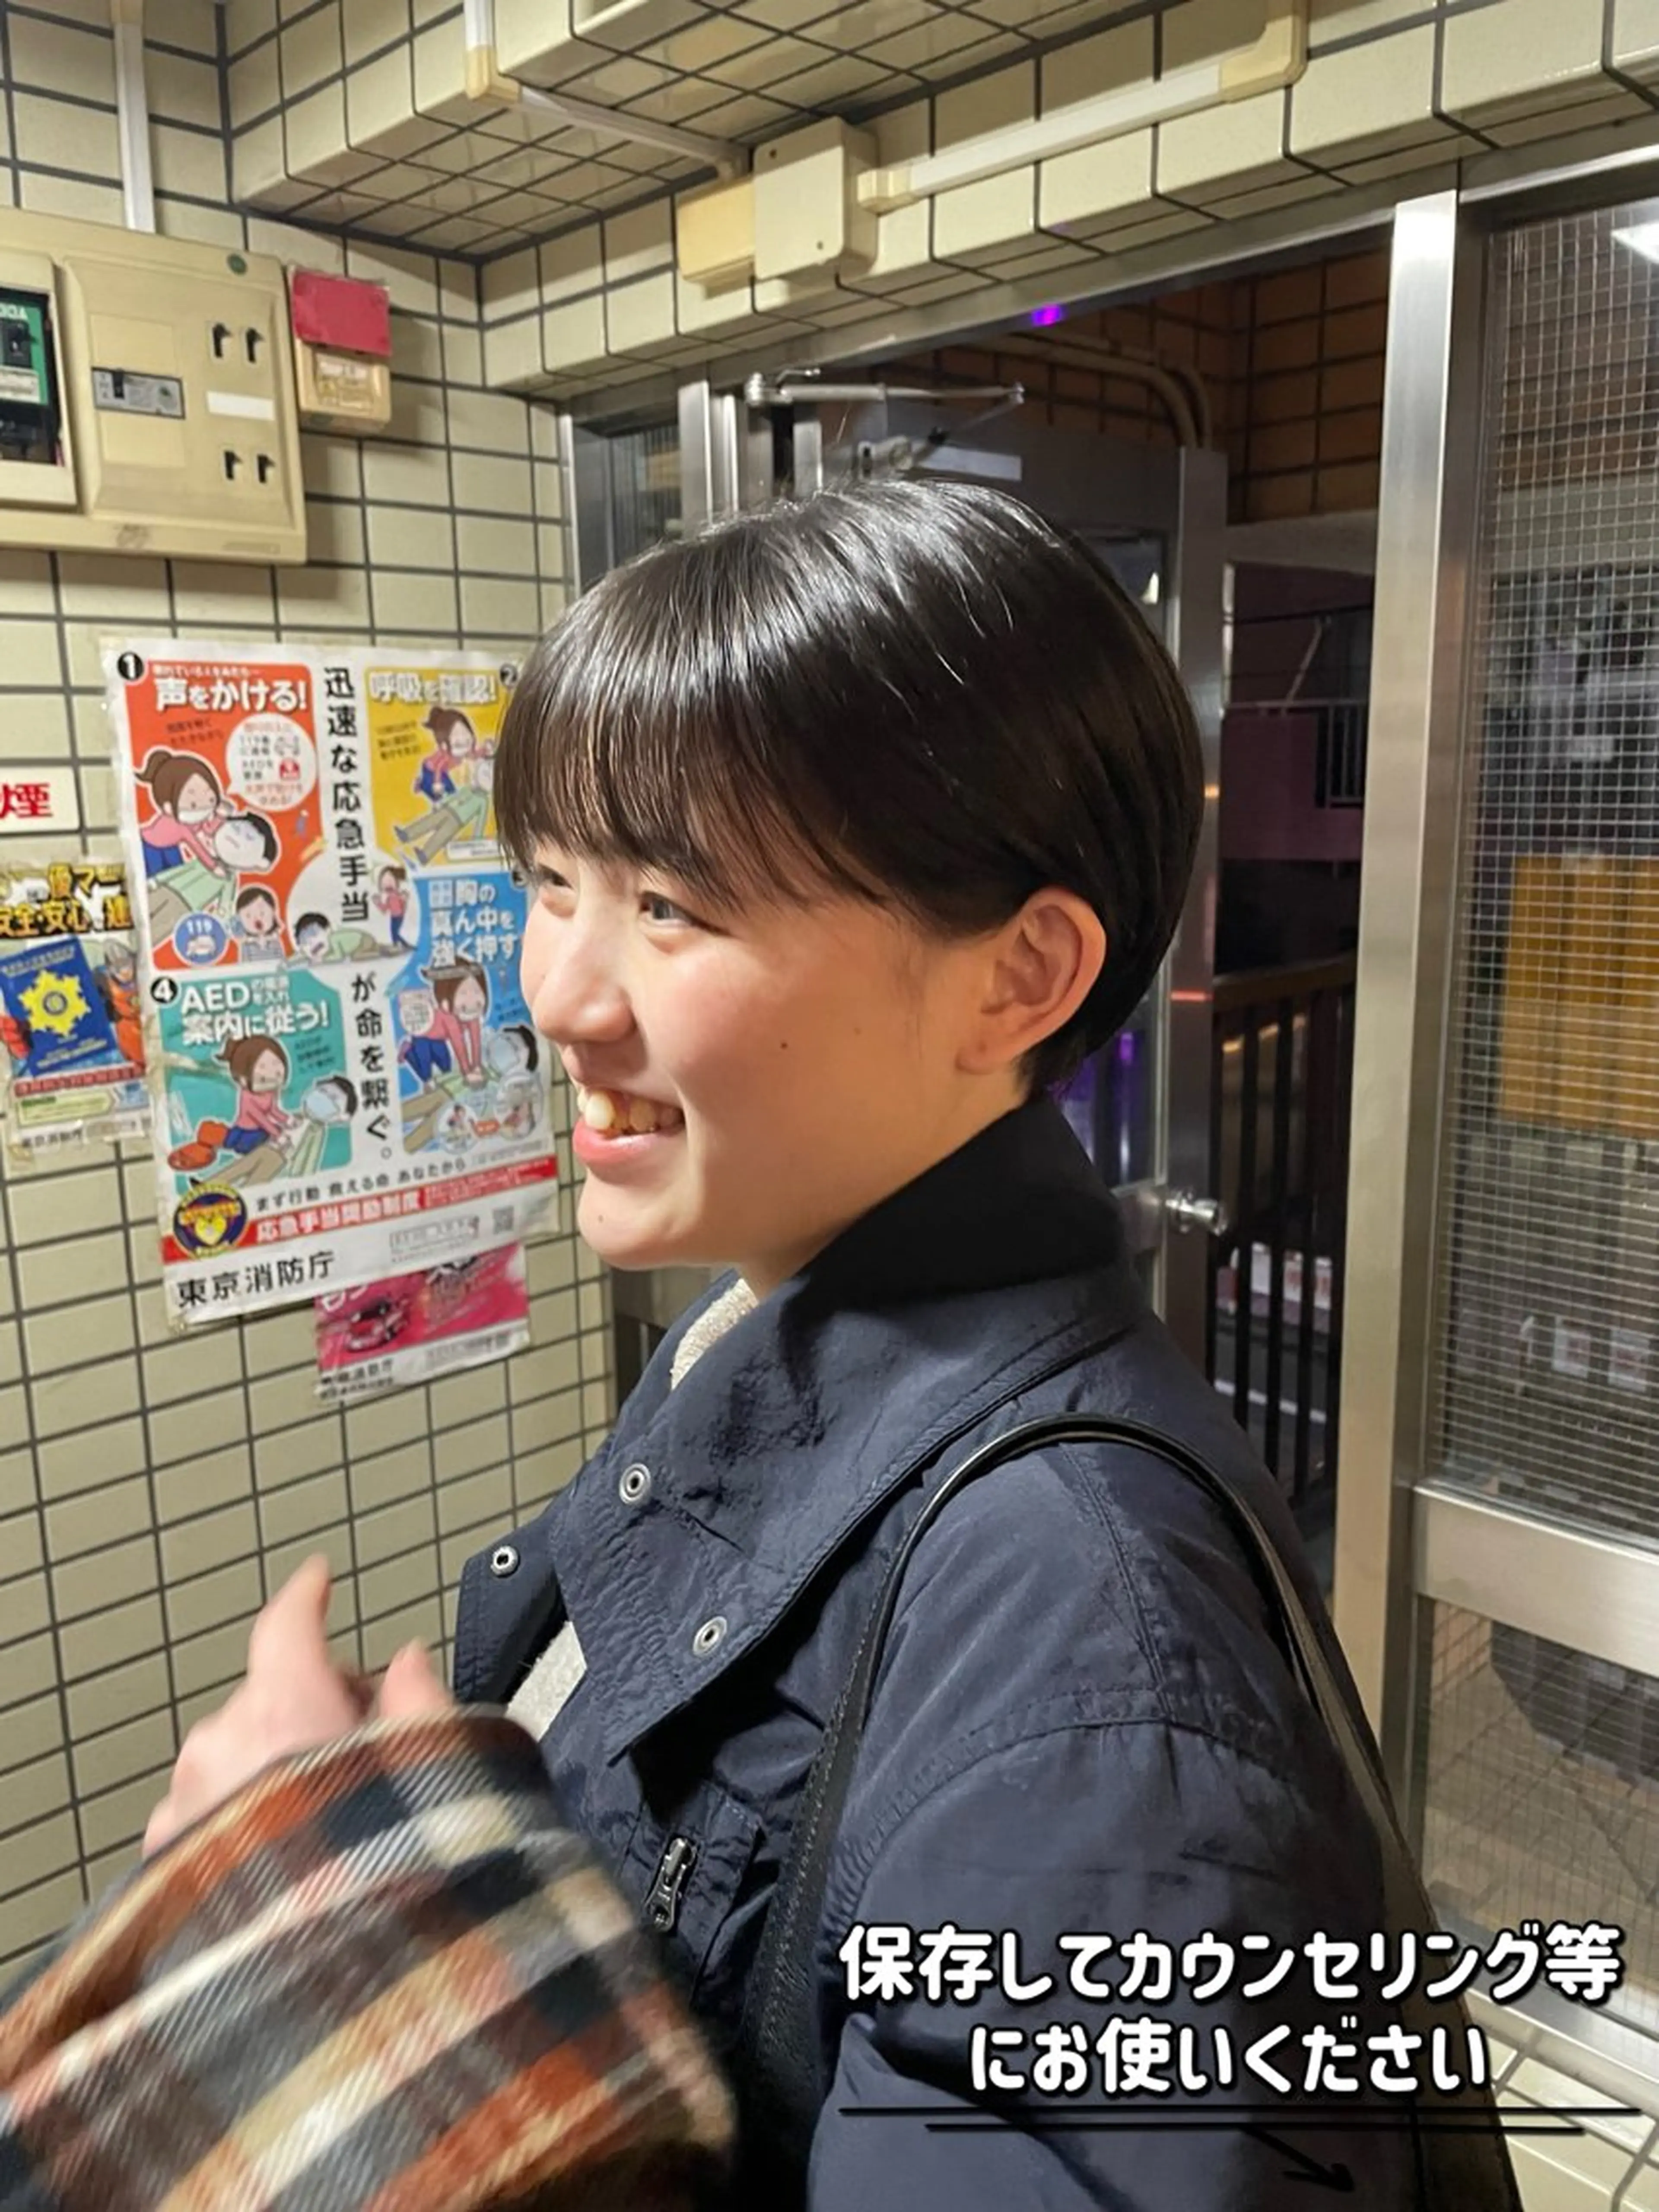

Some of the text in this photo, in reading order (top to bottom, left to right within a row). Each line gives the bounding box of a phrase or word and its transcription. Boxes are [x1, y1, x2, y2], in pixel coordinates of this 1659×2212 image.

[153, 678, 307, 712] 声をかける!
[324, 667, 369, 922] 迅速な応急手当
[181, 981, 250, 1014] AED
[182, 1000, 328, 1045] 案内に従う!
[351, 970, 392, 1159] が命を繋ぐ。
[178, 1250, 335, 1309] 東京消防庁
